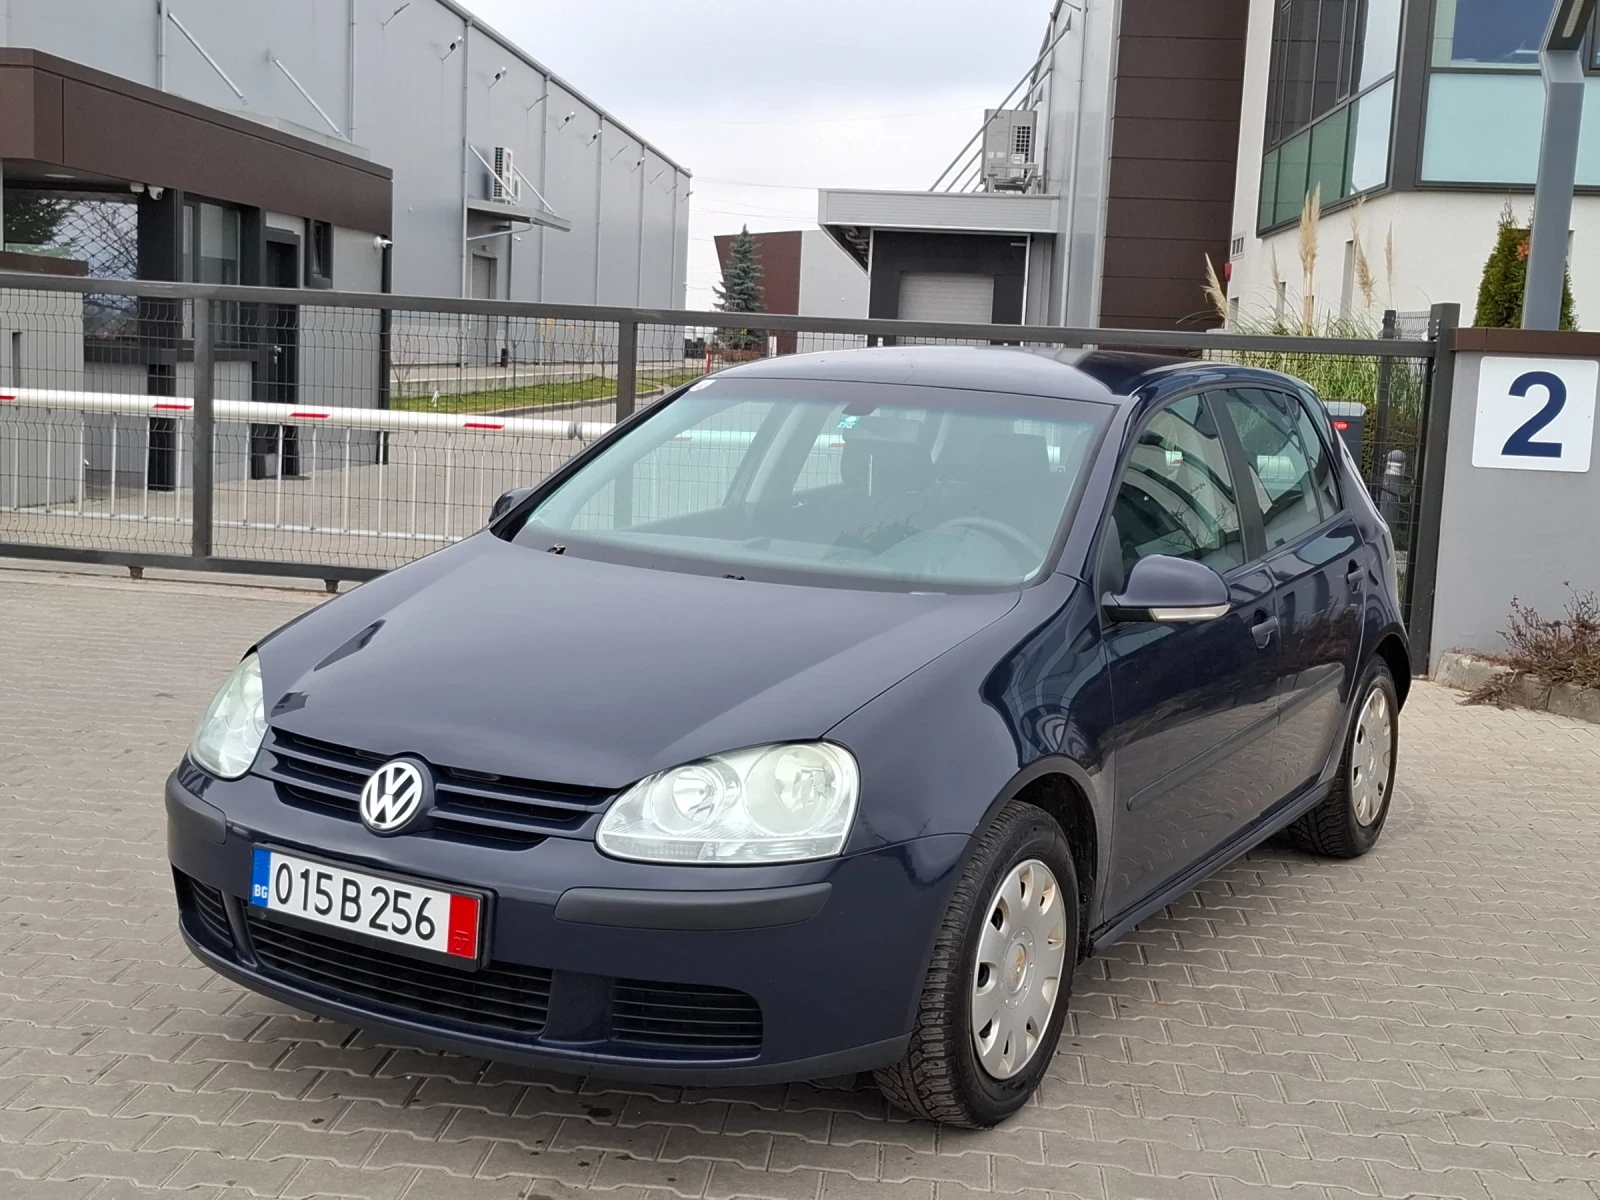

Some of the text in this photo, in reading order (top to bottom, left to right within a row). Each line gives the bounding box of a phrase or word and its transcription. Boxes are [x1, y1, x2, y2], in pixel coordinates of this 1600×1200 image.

[1500, 370, 1567, 459] 2
[364, 763, 420, 827] VW
[254, 884, 268, 899] BG
[275, 862, 436, 941] 015B256
